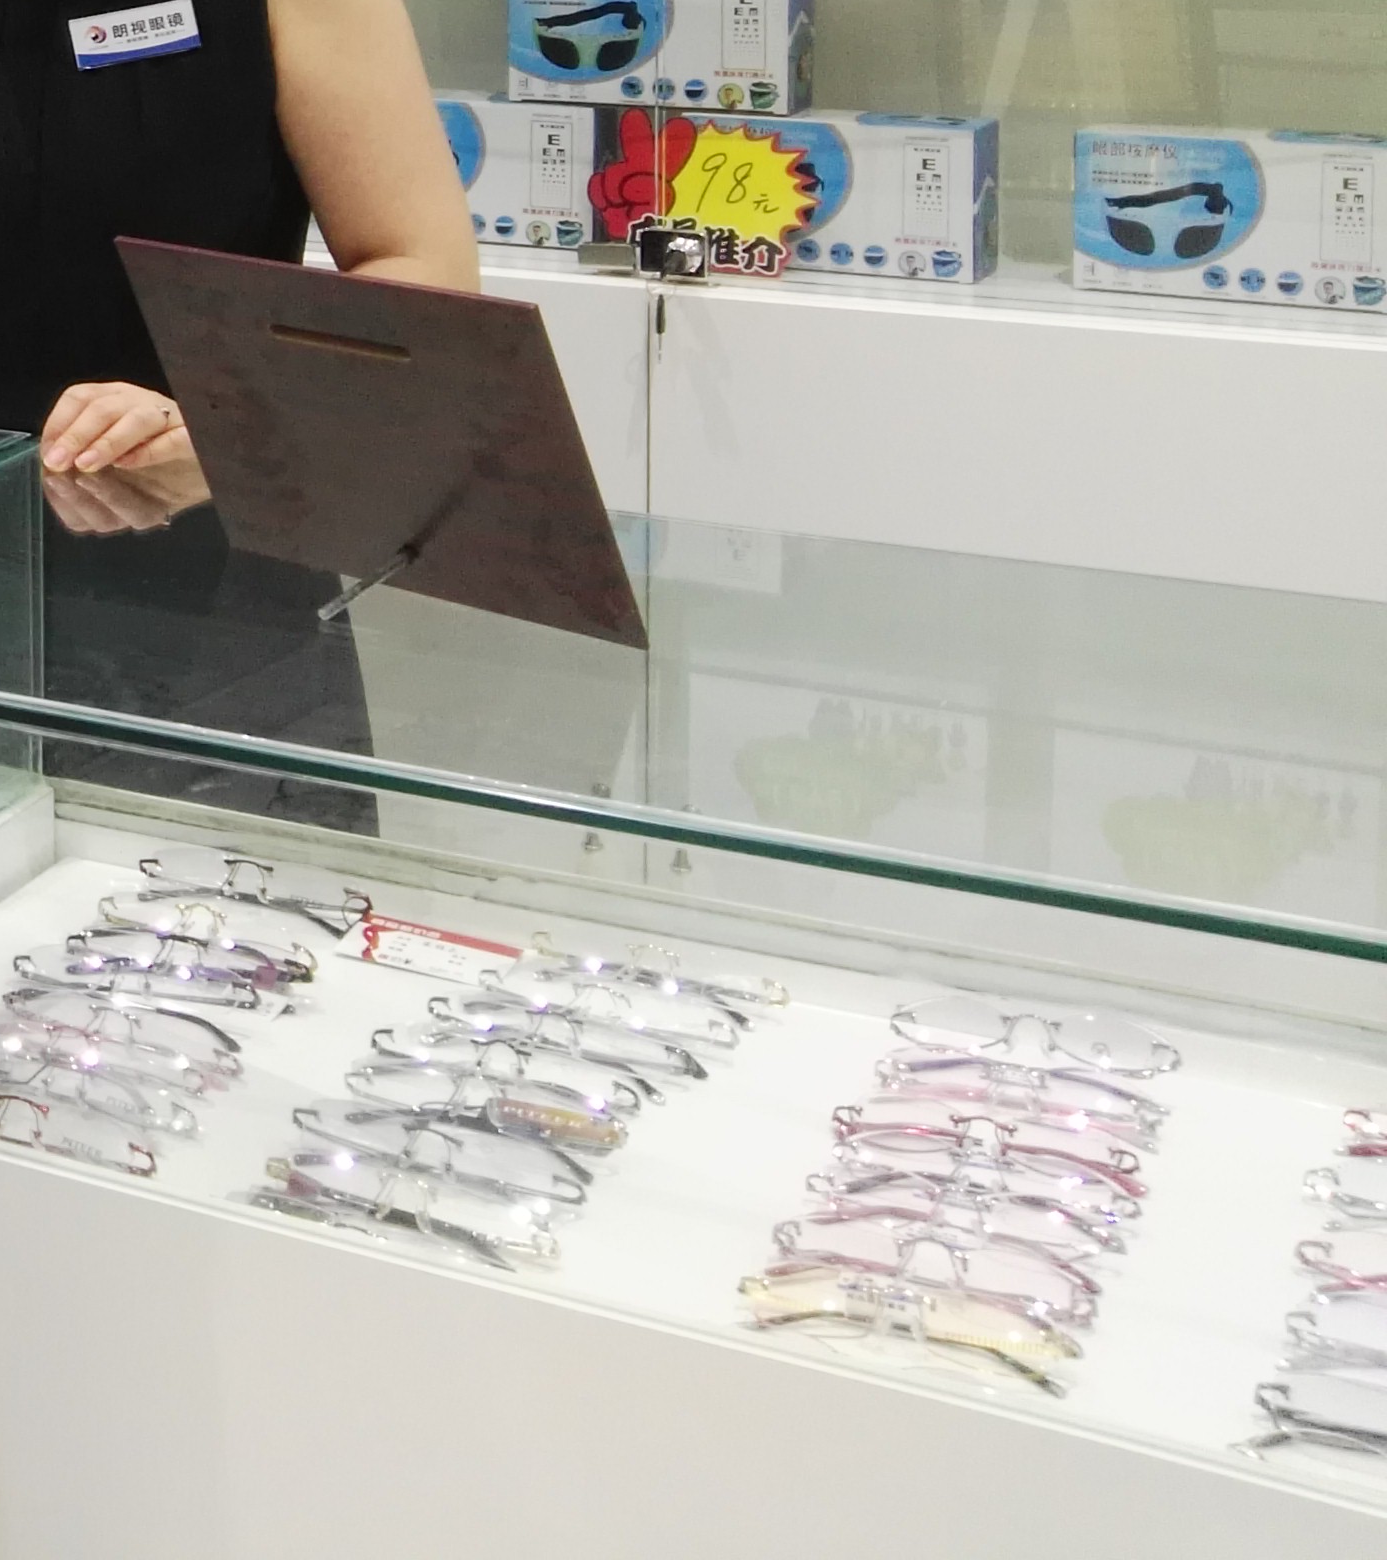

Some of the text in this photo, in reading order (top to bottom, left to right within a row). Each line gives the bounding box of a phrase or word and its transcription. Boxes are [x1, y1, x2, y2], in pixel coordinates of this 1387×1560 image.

[112, 12, 185, 38] 朗视眼镜
[630, 215, 786, 273] 推介
